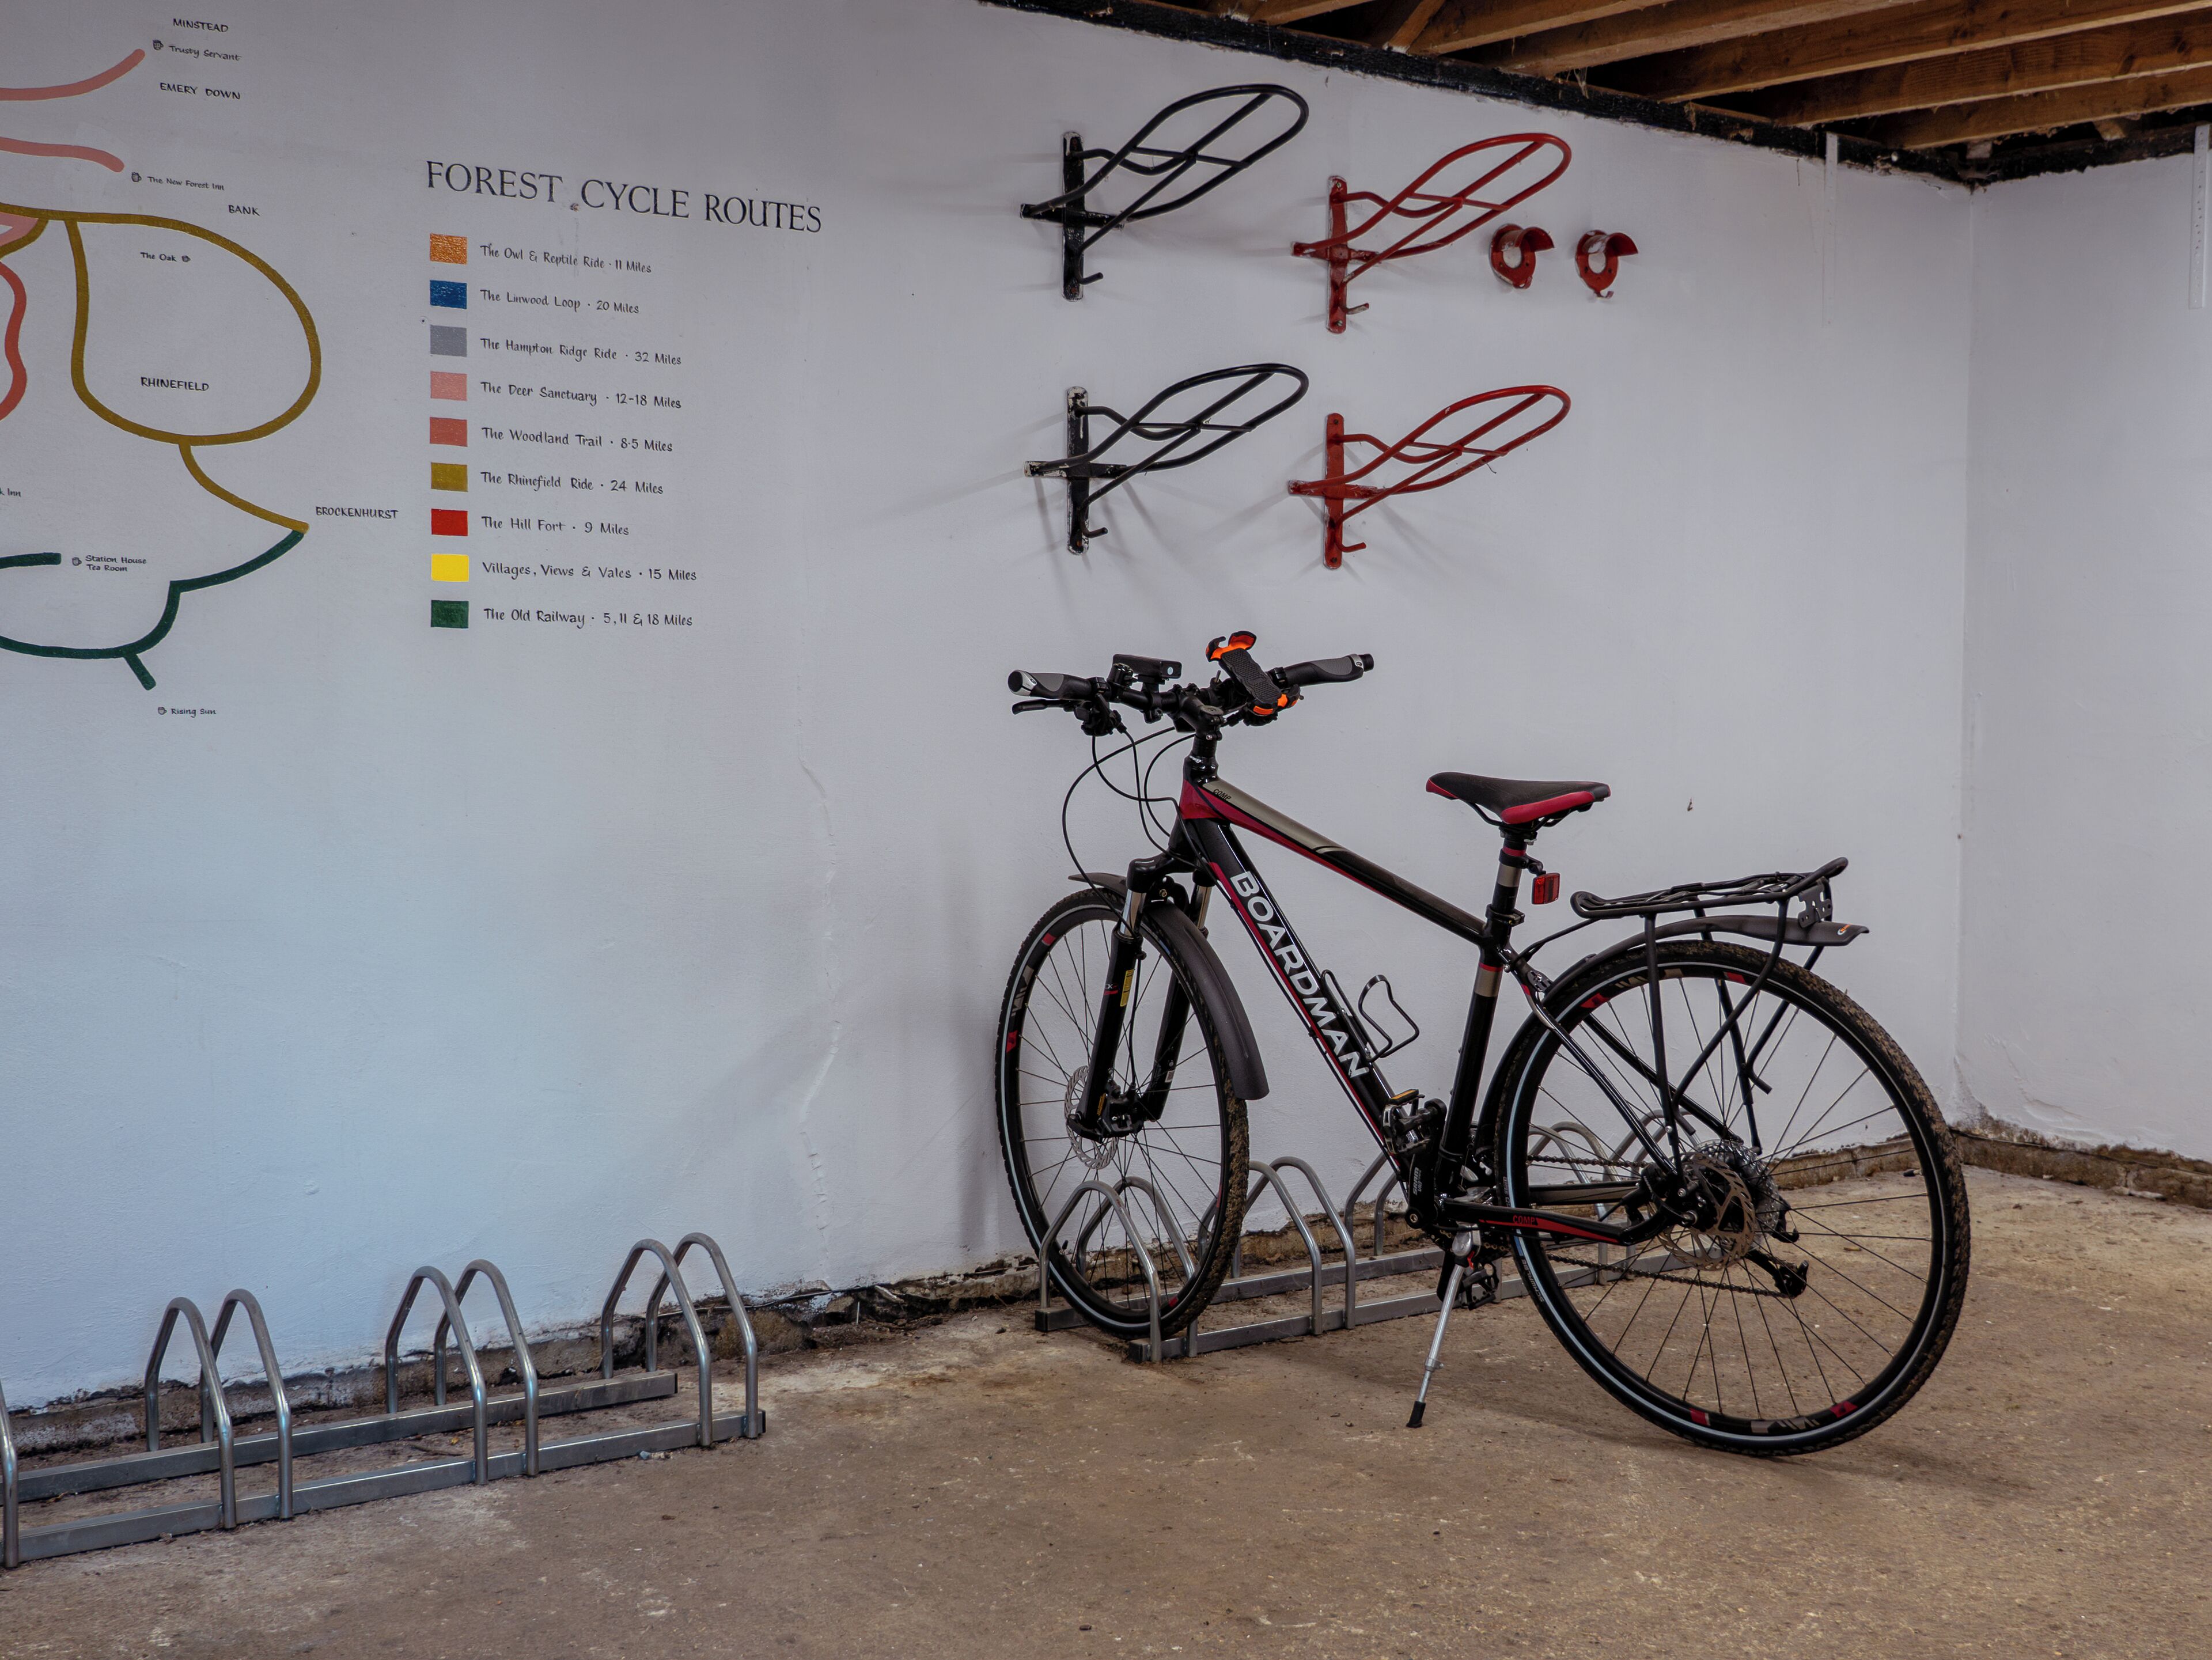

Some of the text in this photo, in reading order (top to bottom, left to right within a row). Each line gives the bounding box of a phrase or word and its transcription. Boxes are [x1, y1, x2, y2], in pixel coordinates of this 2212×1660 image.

[173, 18, 229, 33] MINSTEAD
[168, 45, 242, 62] Trusty Servant
[160, 82, 241, 100] EMERY DOWN
[146, 176, 225, 191] The New Forest Inn
[426, 160, 821, 233] FOREST CYCLE ROUTES
[228, 204, 260, 217] BANK
[139, 251, 177, 262] The Oak
[479, 242, 652, 273] The Owl & Reptile Ride 11 Miles
[479, 289, 639, 314] The Linwood Loop 20 Miles
[479, 338, 682, 365] The Hampton Ridge Ride 32 Miles
[140, 376, 210, 392] RHINEFIELD
[480, 381, 682, 409] The Deer Sanctuary 12-18 Miles
[480, 427, 505, 440] The
[509, 429, 570, 445] Woodland
[574, 434, 603, 448] Trail
[644, 439, 673, 452] Miles
[480, 471, 664, 495] The Rhinefield Ride 24 Miles
[7, 487, 21, 498] Inn
[315, 506, 399, 520] BROCKENHURST
[480, 516, 630, 536] The Hill Fort 9 Miles
[84, 554, 147, 564] Station House
[85, 563, 128, 572] Tea Room
[482, 562, 697, 581] Villages, Views & Vales 15 Miles
[483, 608, 505, 620] The
[510, 608, 531, 622] Old
[535, 609, 585, 630] Railway
[632, 613, 643, 627] &
[647, 613, 660, 626] 18
[664, 614, 693, 626] Miles
[170, 708, 197, 718] Rising
[1213, 788, 1232, 801] COMP
[1230, 870, 1370, 1079] BOARDMAN
[1513, 1214, 1536, 1226] COMP
[1521, 1259, 1545, 1303] SCHWALBE
